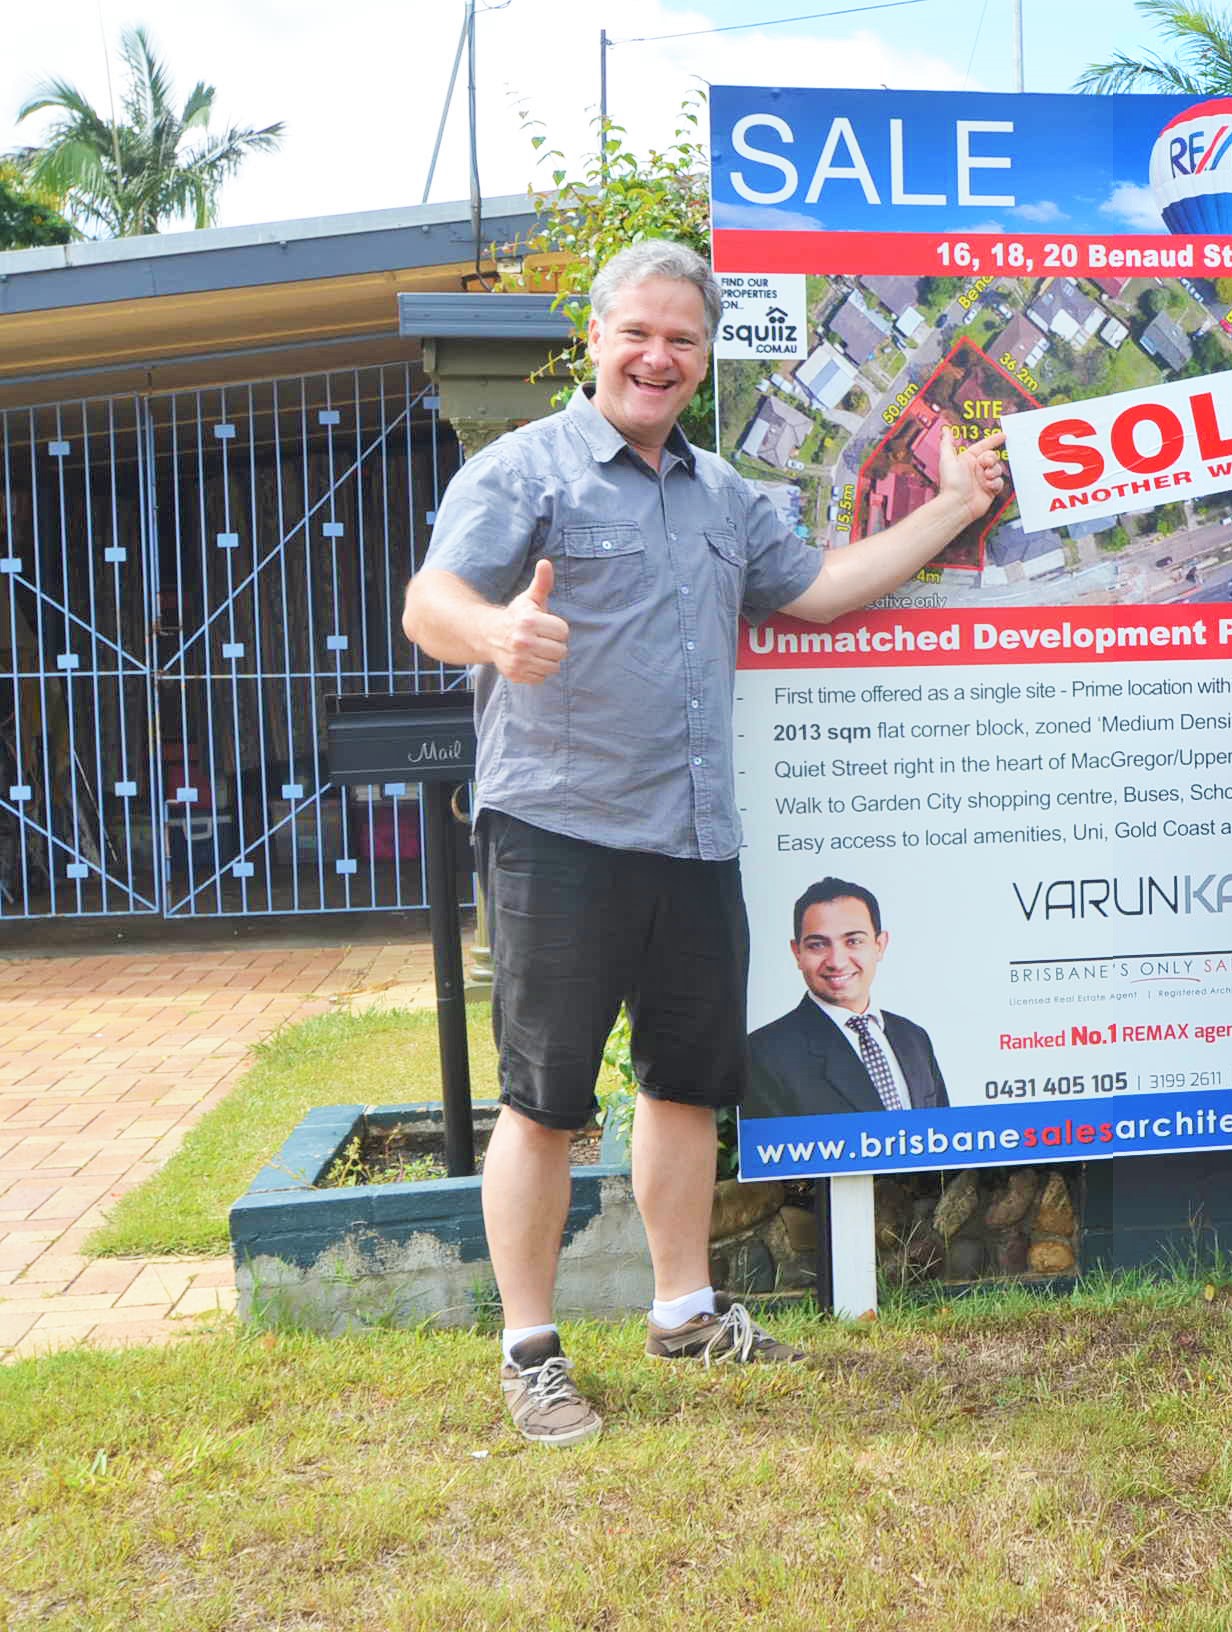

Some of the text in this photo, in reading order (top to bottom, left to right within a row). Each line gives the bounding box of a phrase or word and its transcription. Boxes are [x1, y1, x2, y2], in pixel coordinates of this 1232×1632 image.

[729, 113, 1017, 207] SALE
[937, 242, 980, 271] 16,
[991, 243, 1033, 271] 18,
[1044, 244, 1078, 268] 20
[1088, 244, 1194, 268] Benaud
[721, 278, 768, 287] FIND OUR
[721, 289, 777, 299] PROPERTIES
[962, 400, 1003, 420] SITE
[1049, 471, 1192, 512] ANOTHER
[749, 624, 960, 655] Unmatched
[974, 621, 1207, 654] Development
[774, 687, 814, 704] First
[818, 687, 856, 703] time
[861, 685, 922, 703] offered
[927, 687, 949, 701] as
[953, 687, 966, 700] a
[971, 683, 1021, 703] single
[1026, 681, 1056, 699] site
[1072, 680, 1123, 698] Prime
[1128, 679, 1192, 696] location
[773, 724, 821, 742] 2013
[828, 726, 871, 743] sqm
[877, 722, 905, 738] flat
[911, 724, 970, 738] corner
[976, 718, 1029, 738] block,
[1035, 717, 1091, 735] zoned
[408, 740, 462, 763] Mail
[774, 760, 826, 779] Quiet
[831, 758, 888, 777] Street
[894, 757, 933, 779] right
[939, 756, 955, 774] in
[962, 756, 990, 773] the
[996, 754, 1043, 772] heart
[1048, 753, 1066, 770] of
[775, 796, 822, 815] Walk
[828, 798, 846, 814] to
[851, 794, 921, 813] Garden
[927, 792, 962, 813] City
[967, 790, 1050, 811] shopping
[1057, 788, 1117, 806] centre,
[1124, 785, 1184, 803] Buses,
[777, 834, 824, 854] Easy
[830, 834, 896, 849] access
[902, 832, 920, 847] to
[925, 828, 967, 846] local
[974, 825, 1066, 844] amenities,
[1073, 824, 1108, 841] Uni,
[1115, 821, 1157, 839] Gold
[1163, 818, 1216, 837] Coast
[1140, 960, 1193, 976] ONLY
[1009, 996, 1051, 1006] Licensed
[1054, 994, 1075, 1004] Real
[1077, 993, 1106, 1003] Estate
[1110, 991, 1138, 1001] Agent
[1158, 988, 1208, 998] Registered
[1000, 1030, 1066, 1050] Ranked
[1071, 1023, 1117, 1046] No.1
[1123, 1023, 1190, 1042] REMAX
[985, 1079, 1036, 1099] 0431
[1043, 1076, 1085, 1095] 405
[1091, 1072, 1128, 1093] 105
[1150, 1073, 1185, 1089] 3199
[1191, 1071, 1222, 1087] 2611
